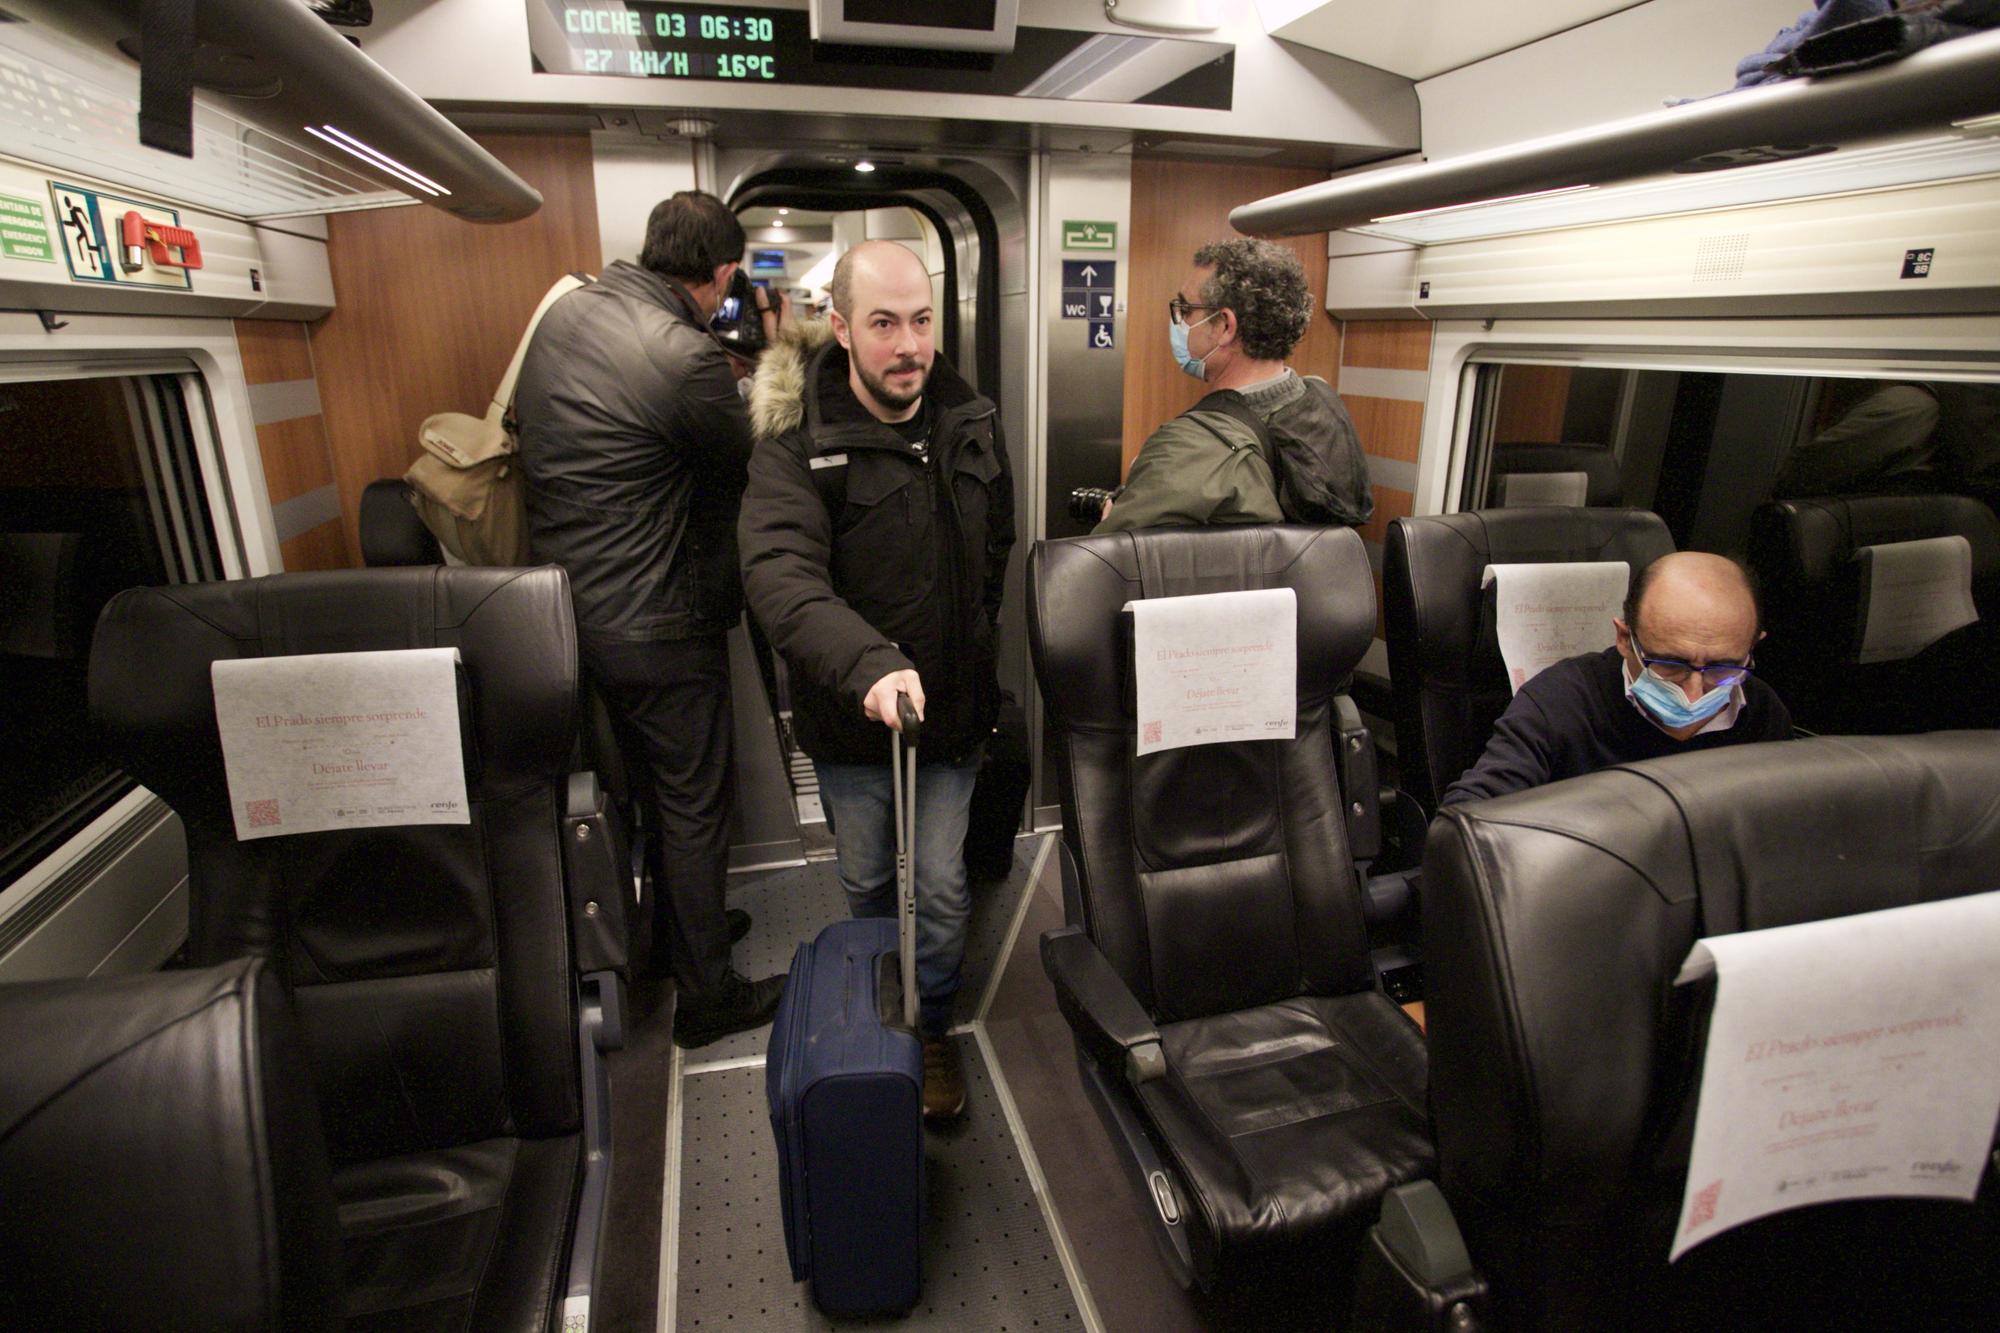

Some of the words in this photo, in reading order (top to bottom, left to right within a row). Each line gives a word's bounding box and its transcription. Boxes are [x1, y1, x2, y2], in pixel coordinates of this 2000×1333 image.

[564, 9, 641, 36] COCHE
[655, 13, 686, 38] 03
[700, 15, 773, 42] 06:30
[0, 200, 31, 214] ENTANA
[1065, 303, 1086, 317] WC
